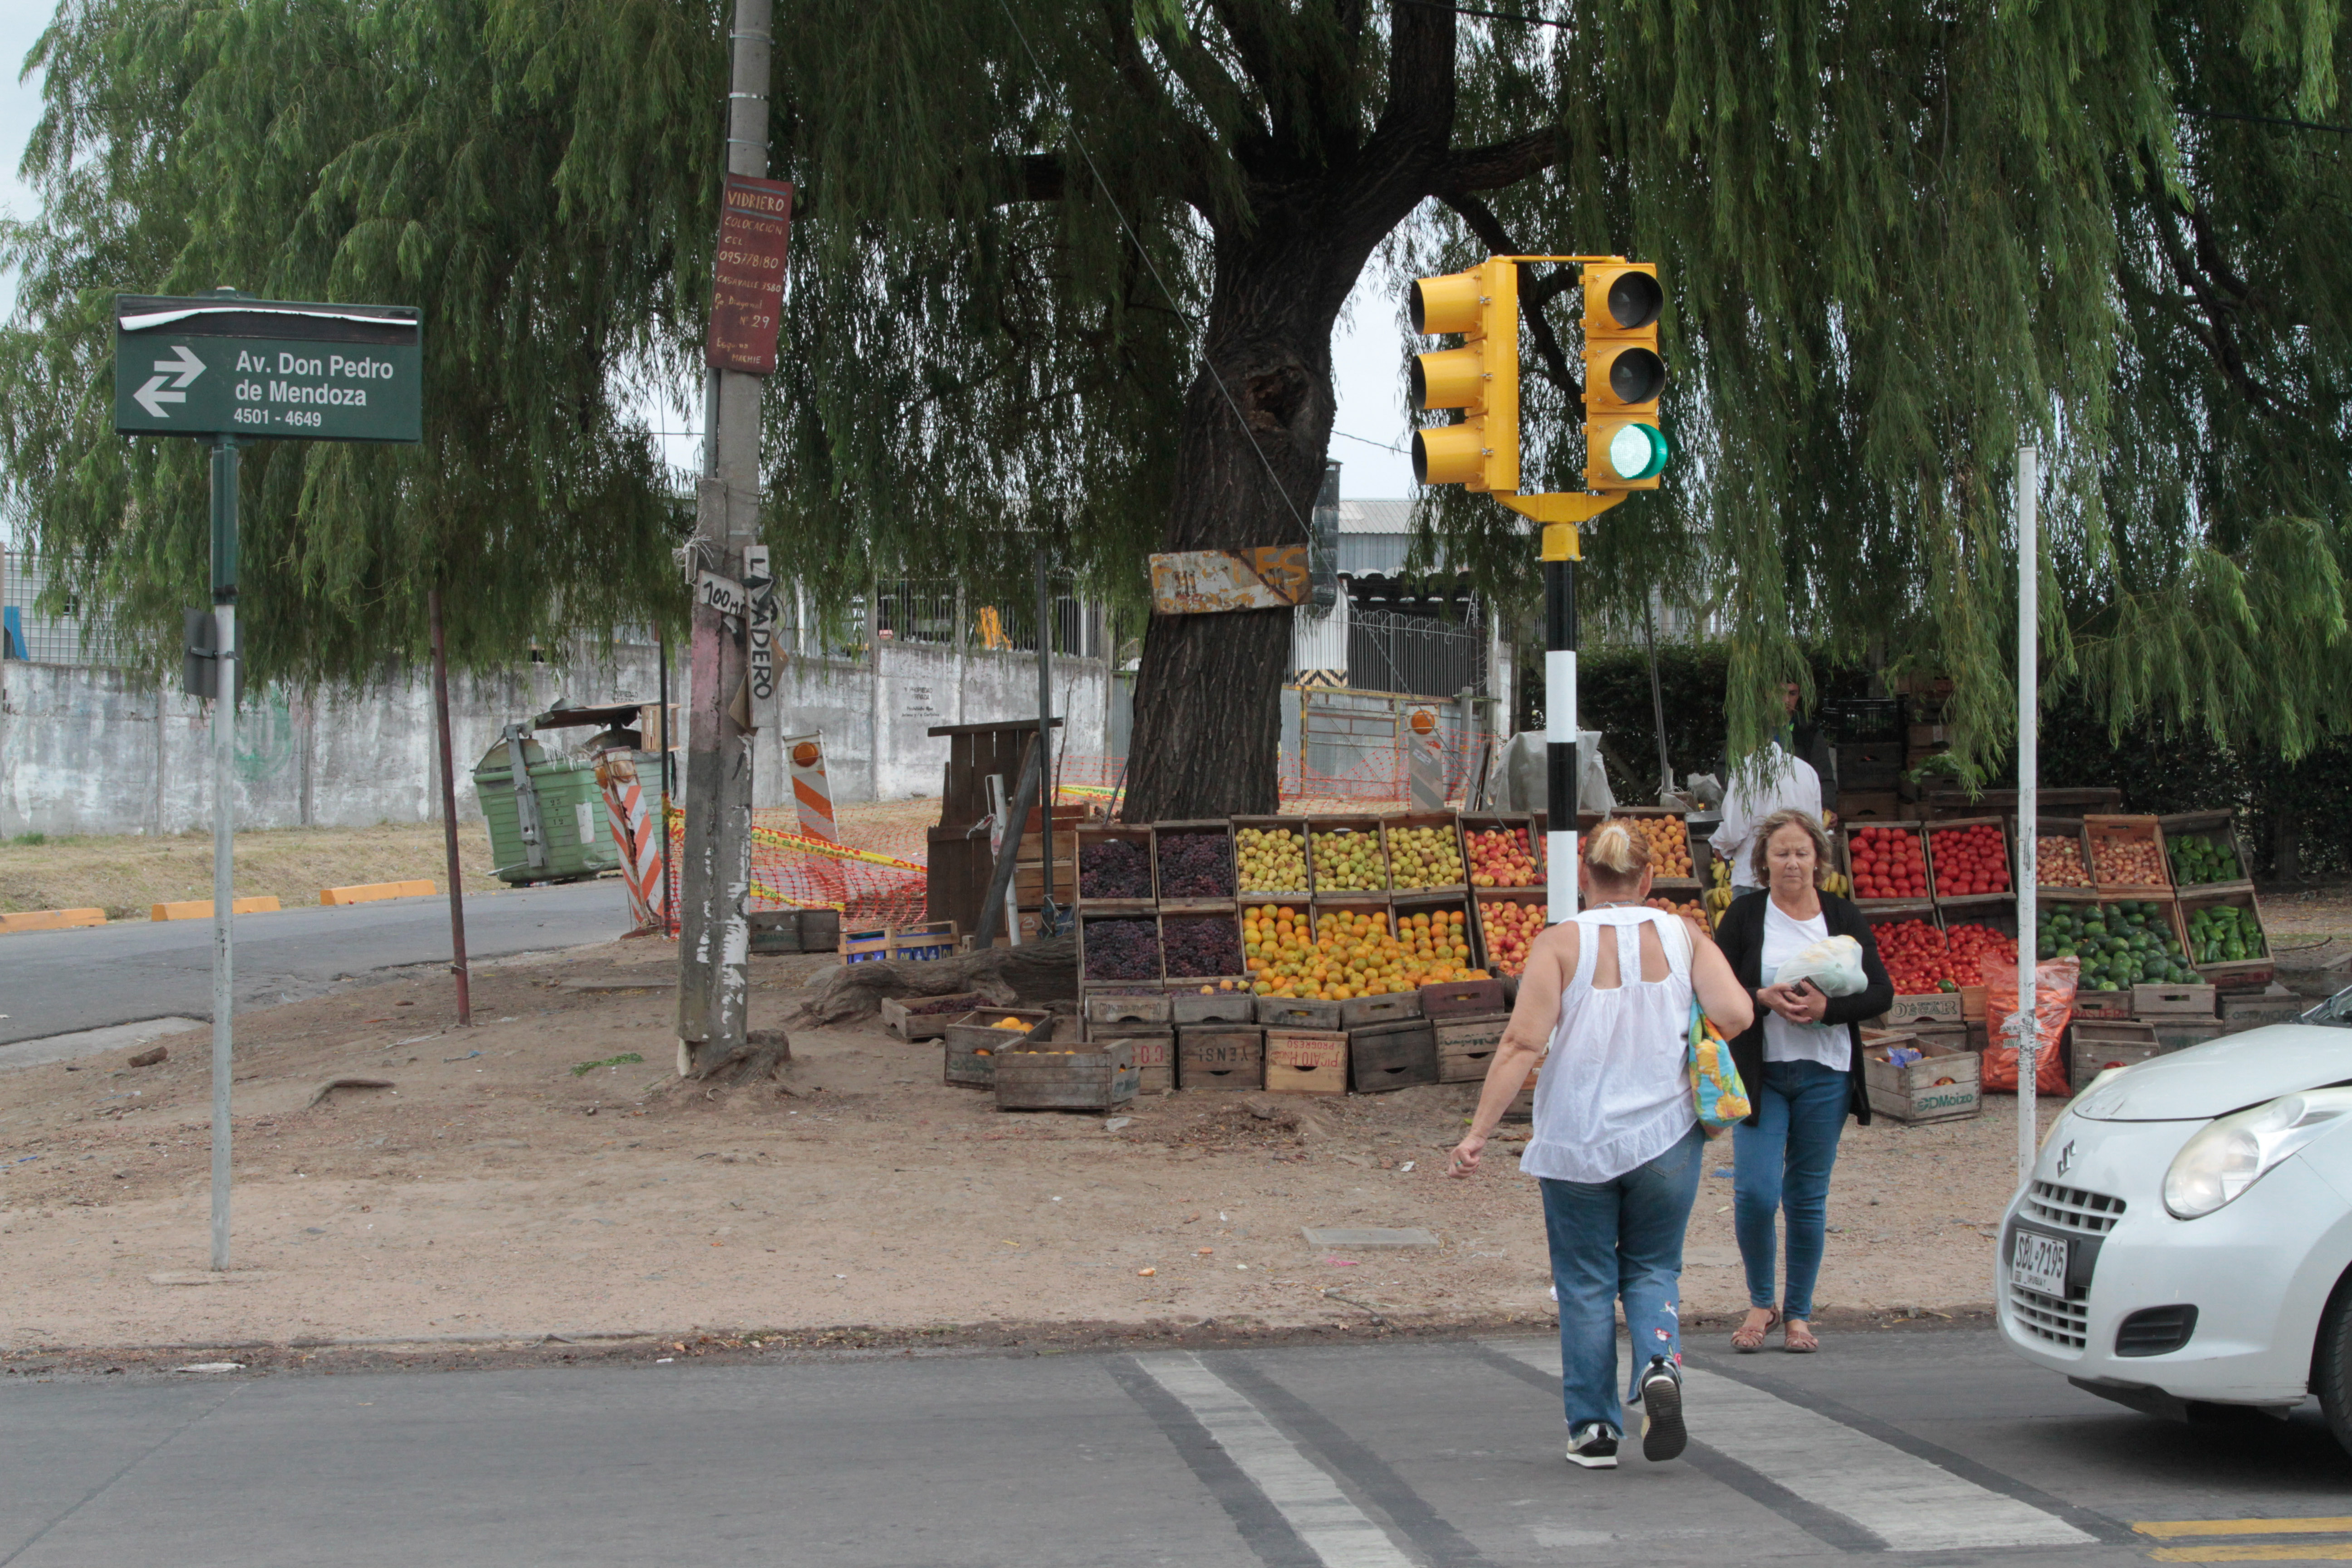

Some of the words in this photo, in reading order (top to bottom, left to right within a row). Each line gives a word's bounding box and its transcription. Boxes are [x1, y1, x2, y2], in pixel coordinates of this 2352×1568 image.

[728, 190, 784, 212] VIDRIERO
[725, 216, 783, 235] COLOCACIÓN
[719, 250, 779, 269] 095778180
[717, 275, 759, 289] CASAVALLE
[751, 315, 770, 329] 29
[235, 351, 271, 373] Av.
[279, 353, 322, 376] Don
[330, 355, 394, 379] Pedro
[235, 379, 262, 401] de
[270, 381, 367, 406] Mendoza
[234, 408, 270, 425] 4501
[285, 411, 322, 427] 4649
[703, 580, 730, 608] 100
[1891, 1000, 1957, 1018] OSCAR
[1287, 1039, 1335, 1050] PROGRESO
[2016, 1236, 2033, 1270] SBL
[2037, 1241, 2064, 1279] 7195
